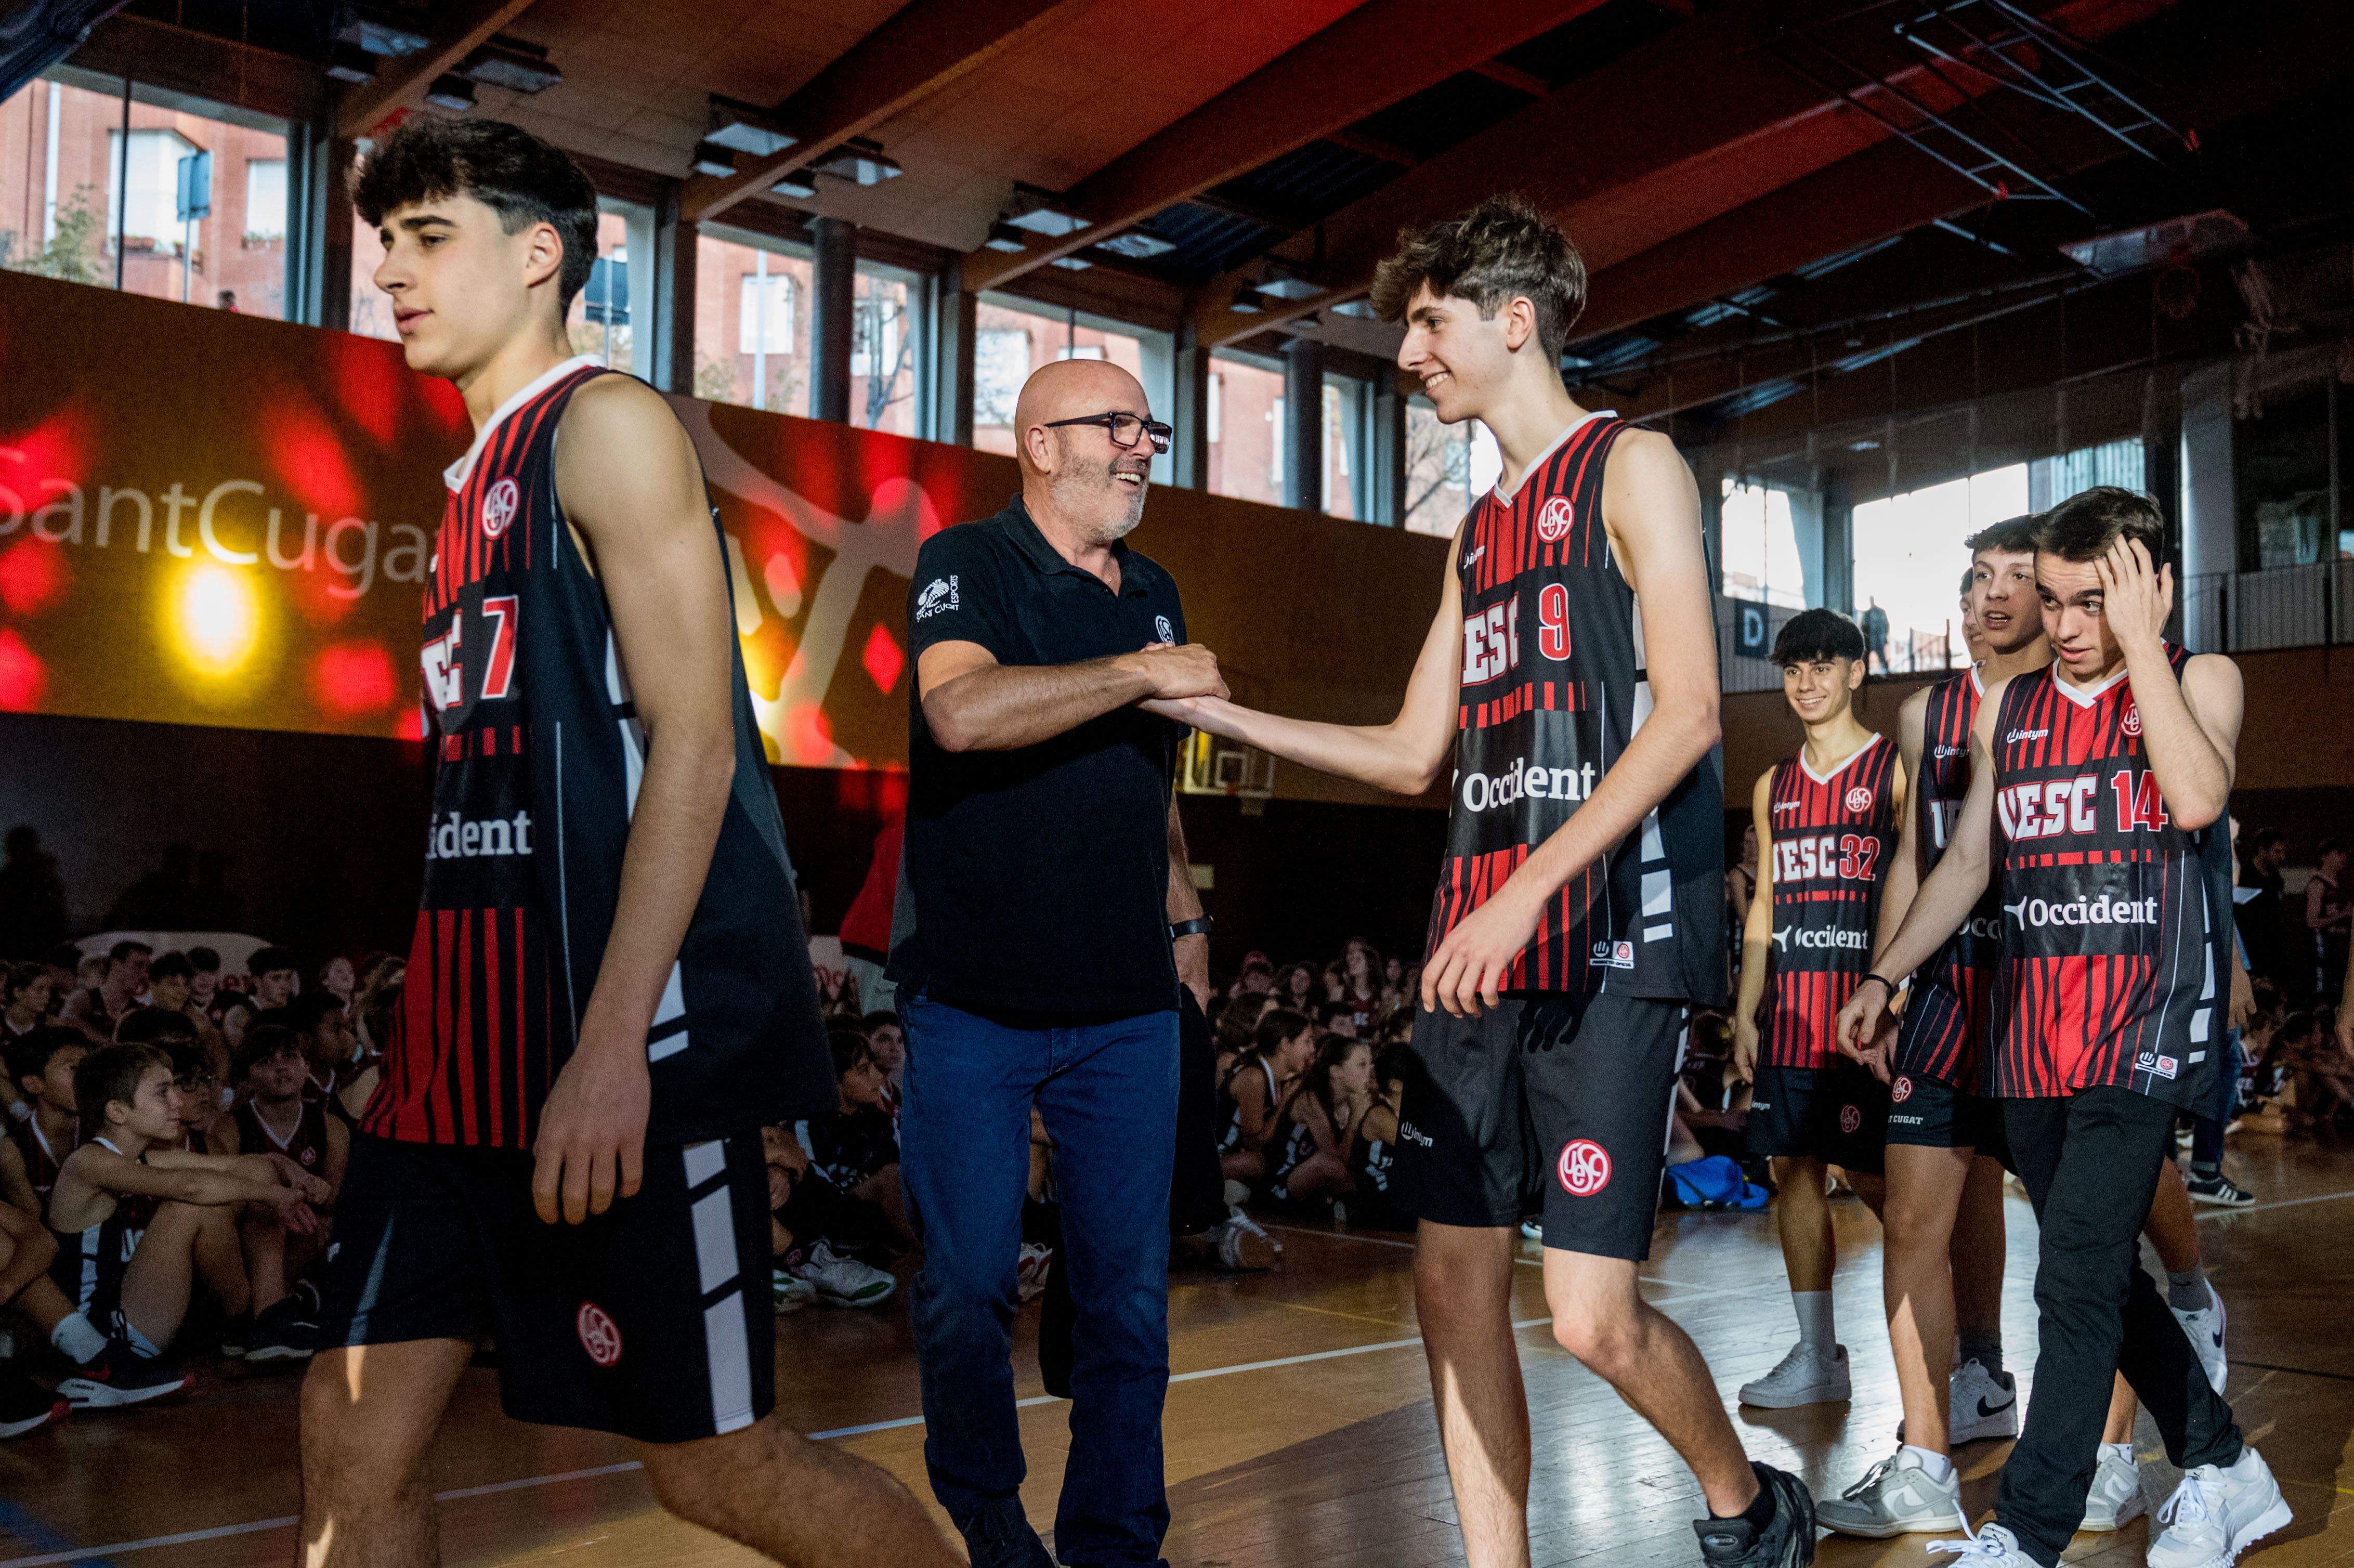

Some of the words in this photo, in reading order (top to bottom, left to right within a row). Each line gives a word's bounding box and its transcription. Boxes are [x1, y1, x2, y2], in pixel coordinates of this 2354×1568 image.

[0, 447, 441, 600] SantCuga
[935, 603, 959, 614] CUGAT
[950, 574, 959, 603] ESPORTS
[1538, 582, 1572, 661] 9
[1743, 608, 1763, 647] D
[480, 595, 519, 700] 7
[2018, 729, 2048, 740] intym
[1462, 757, 1596, 812] Occident
[2111, 769, 2168, 832] 14
[1839, 833, 1881, 882] 32
[2029, 895, 2157, 927] Occident
[1893, 1115, 1924, 1125] CUGAT
